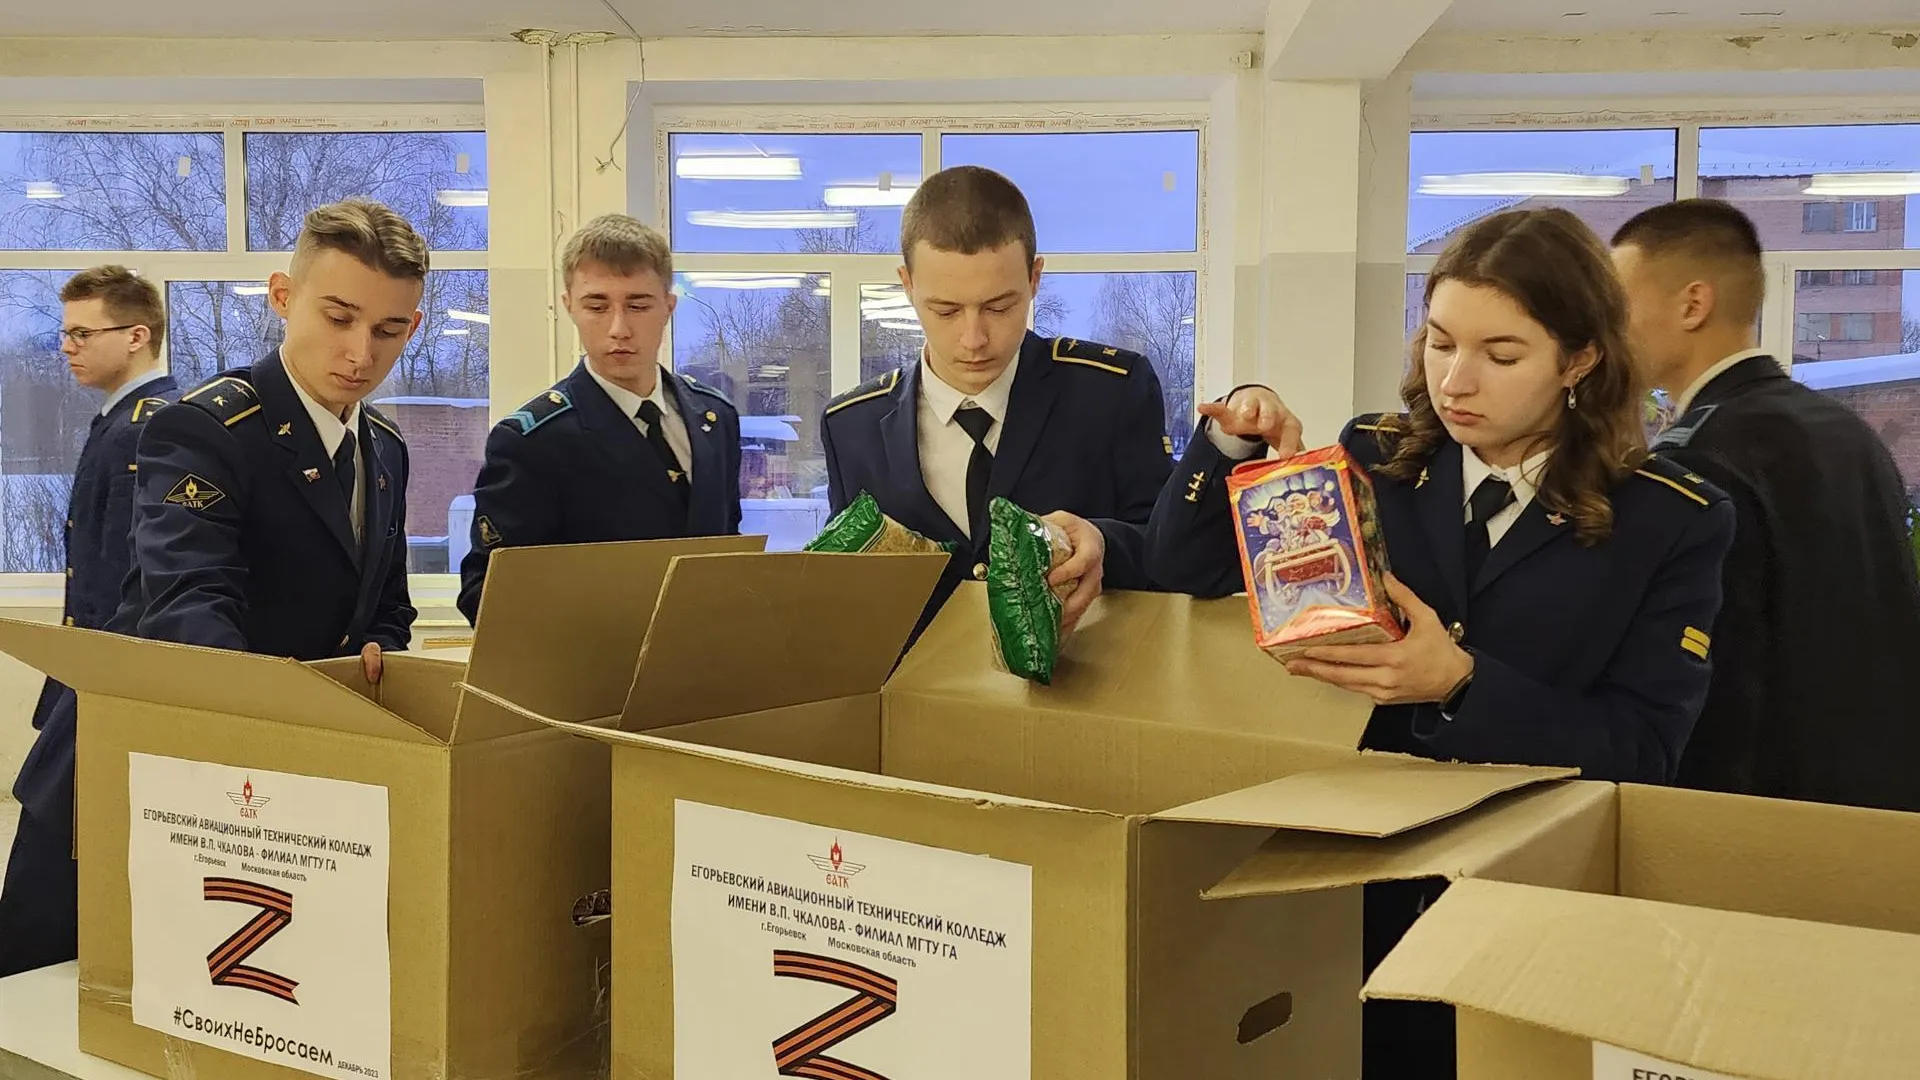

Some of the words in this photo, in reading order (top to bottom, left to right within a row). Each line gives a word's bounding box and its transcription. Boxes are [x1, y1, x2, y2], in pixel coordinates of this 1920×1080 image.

[143, 808, 198, 829] ЕГОРЬЕВСКИЙ
[199, 818, 262, 840] АВИАЦИОННЫЙ
[263, 825, 327, 851] ТЕХНИЧЕСКИЙ
[329, 838, 373, 858] КОЛЛЕДЖ
[170, 831, 199, 848] ИМЕНИ
[200, 837, 216, 851] В.П.
[217, 840, 255, 859] ЧКАЛОВА
[261, 848, 298, 866] ФИЛИАЛ
[299, 854, 325, 870] МГТУ
[325, 858, 337, 872] ГА
[193, 853, 227, 868] г.Егорьевск
[241, 861, 280, 877] Московская
[281, 867, 307, 882] область
[691, 864, 765, 893] ЕГОРЬЕВСКИЙ
[766, 881, 855, 913] АВИАЦИОННЫЙ
[857, 900, 943, 933] ТЕХНИЧЕСКИЙ
[946, 920, 1007, 948] КОЛЛЕДЖ
[728, 893, 767, 915] ИМЕНИ
[769, 903, 791, 921] В.П.
[793, 908, 846, 933] ЧКАЛОВА
[855, 923, 904, 947] ФИЛИАЛ
[906, 935, 940, 955] МГТУ
[942, 943, 957, 960] ГА
[203, 876, 300, 1006] Z
[760, 921, 807, 941] г.Егорьевск
[827, 936, 881, 960] Московская
[882, 951, 917, 968] область
[173, 1006, 334, 1067] #СвоихНеБросаем
[337, 1060, 363, 1074] ДЕКАБРЬ
[364, 1067, 379, 1078] 2023
